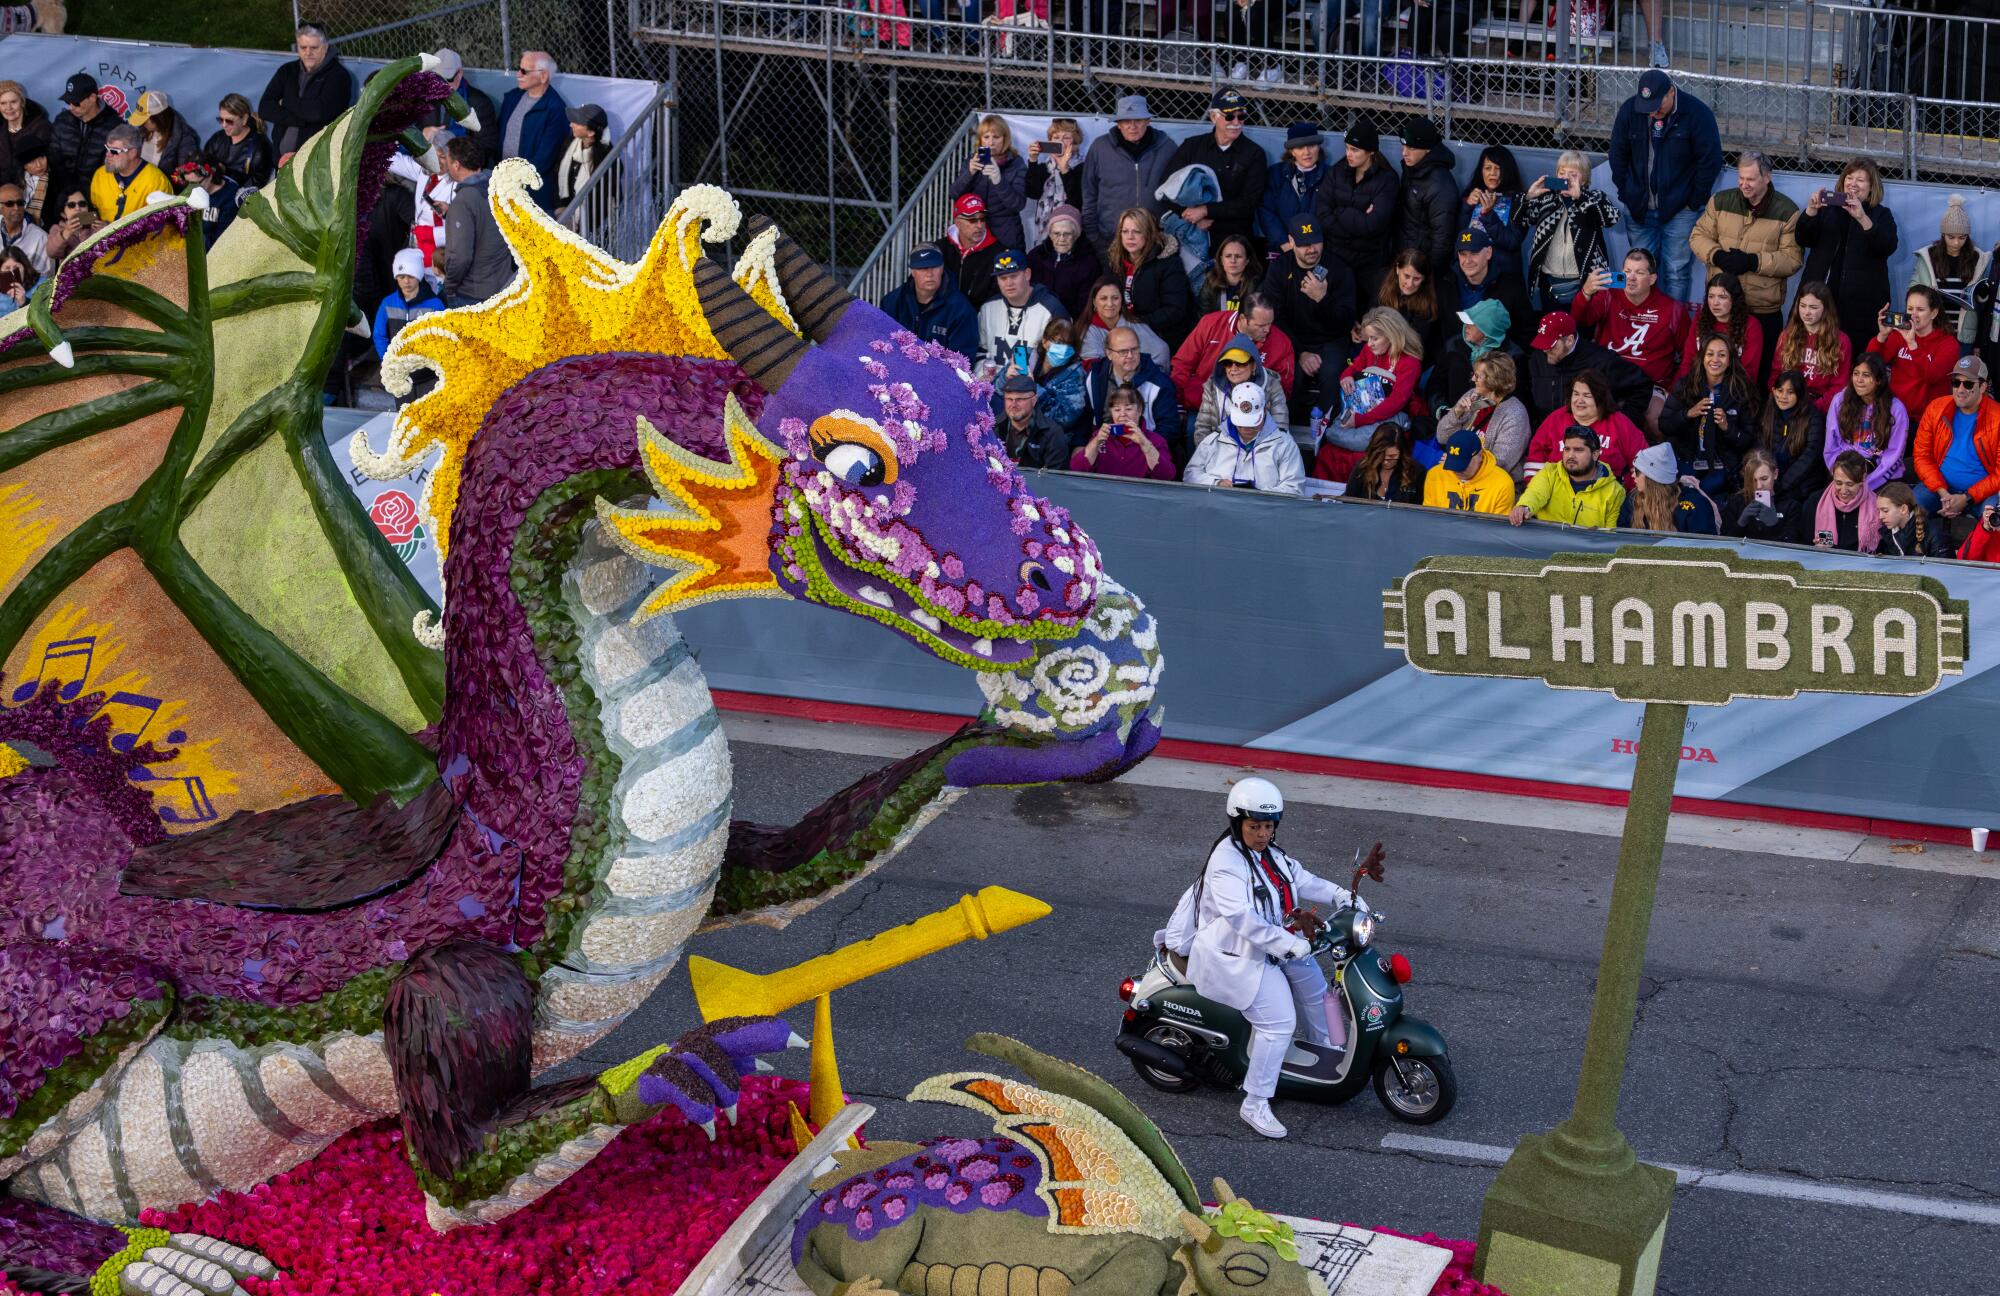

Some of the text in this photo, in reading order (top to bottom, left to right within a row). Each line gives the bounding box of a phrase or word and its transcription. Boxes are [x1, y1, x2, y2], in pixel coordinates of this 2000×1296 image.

[99, 63, 147, 95] PARA
[1301, 224, 1313, 234] M
[1461, 233, 1472, 242] M
[1607, 321, 1650, 356] A
[1449, 446, 1460, 456] M
[1423, 588, 1918, 678] ALHAMBRA
[1611, 738, 1719, 764] HDA
[1163, 1000, 1203, 1018] HONDA
